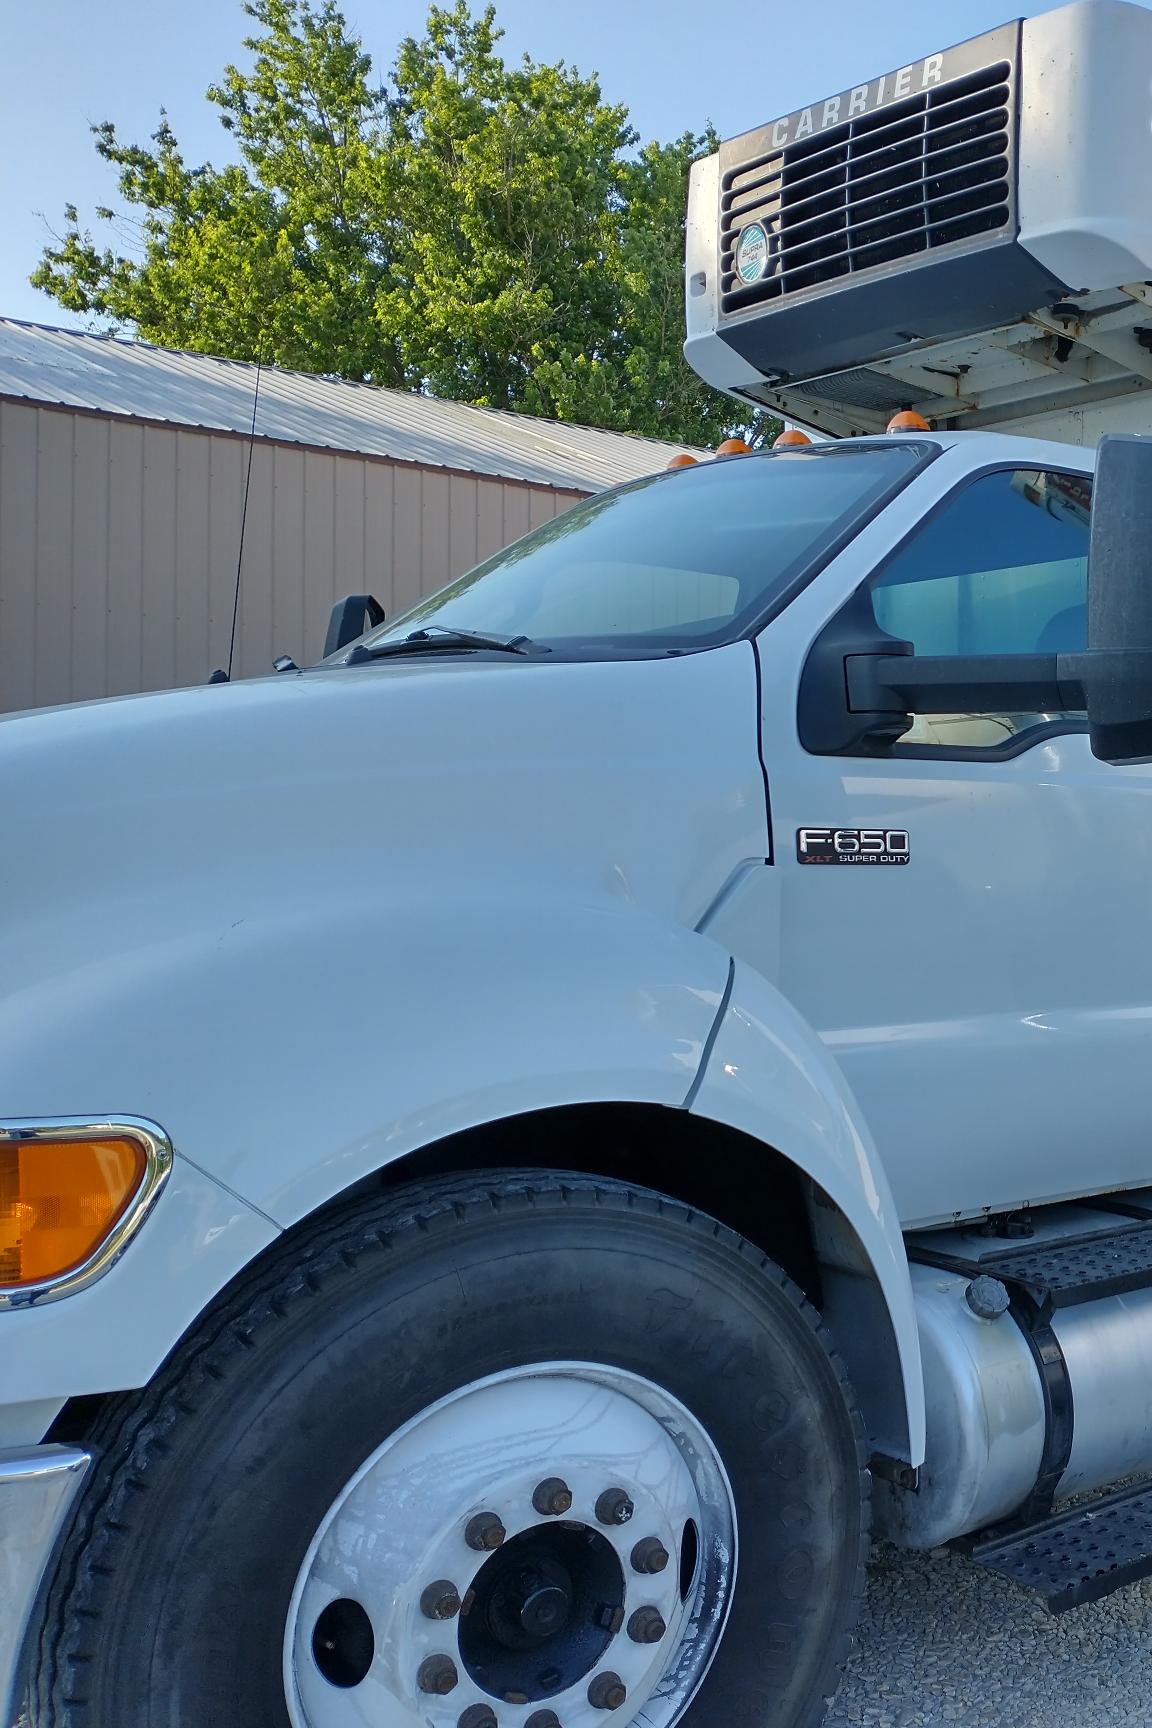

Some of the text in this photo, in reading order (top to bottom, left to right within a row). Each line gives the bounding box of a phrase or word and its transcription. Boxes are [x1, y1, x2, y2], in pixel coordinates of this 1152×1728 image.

[772, 53, 943, 148] CARRIER
[742, 242, 763, 257] SUPRA
[805, 855, 910, 863] XLT SUPER DUTY
